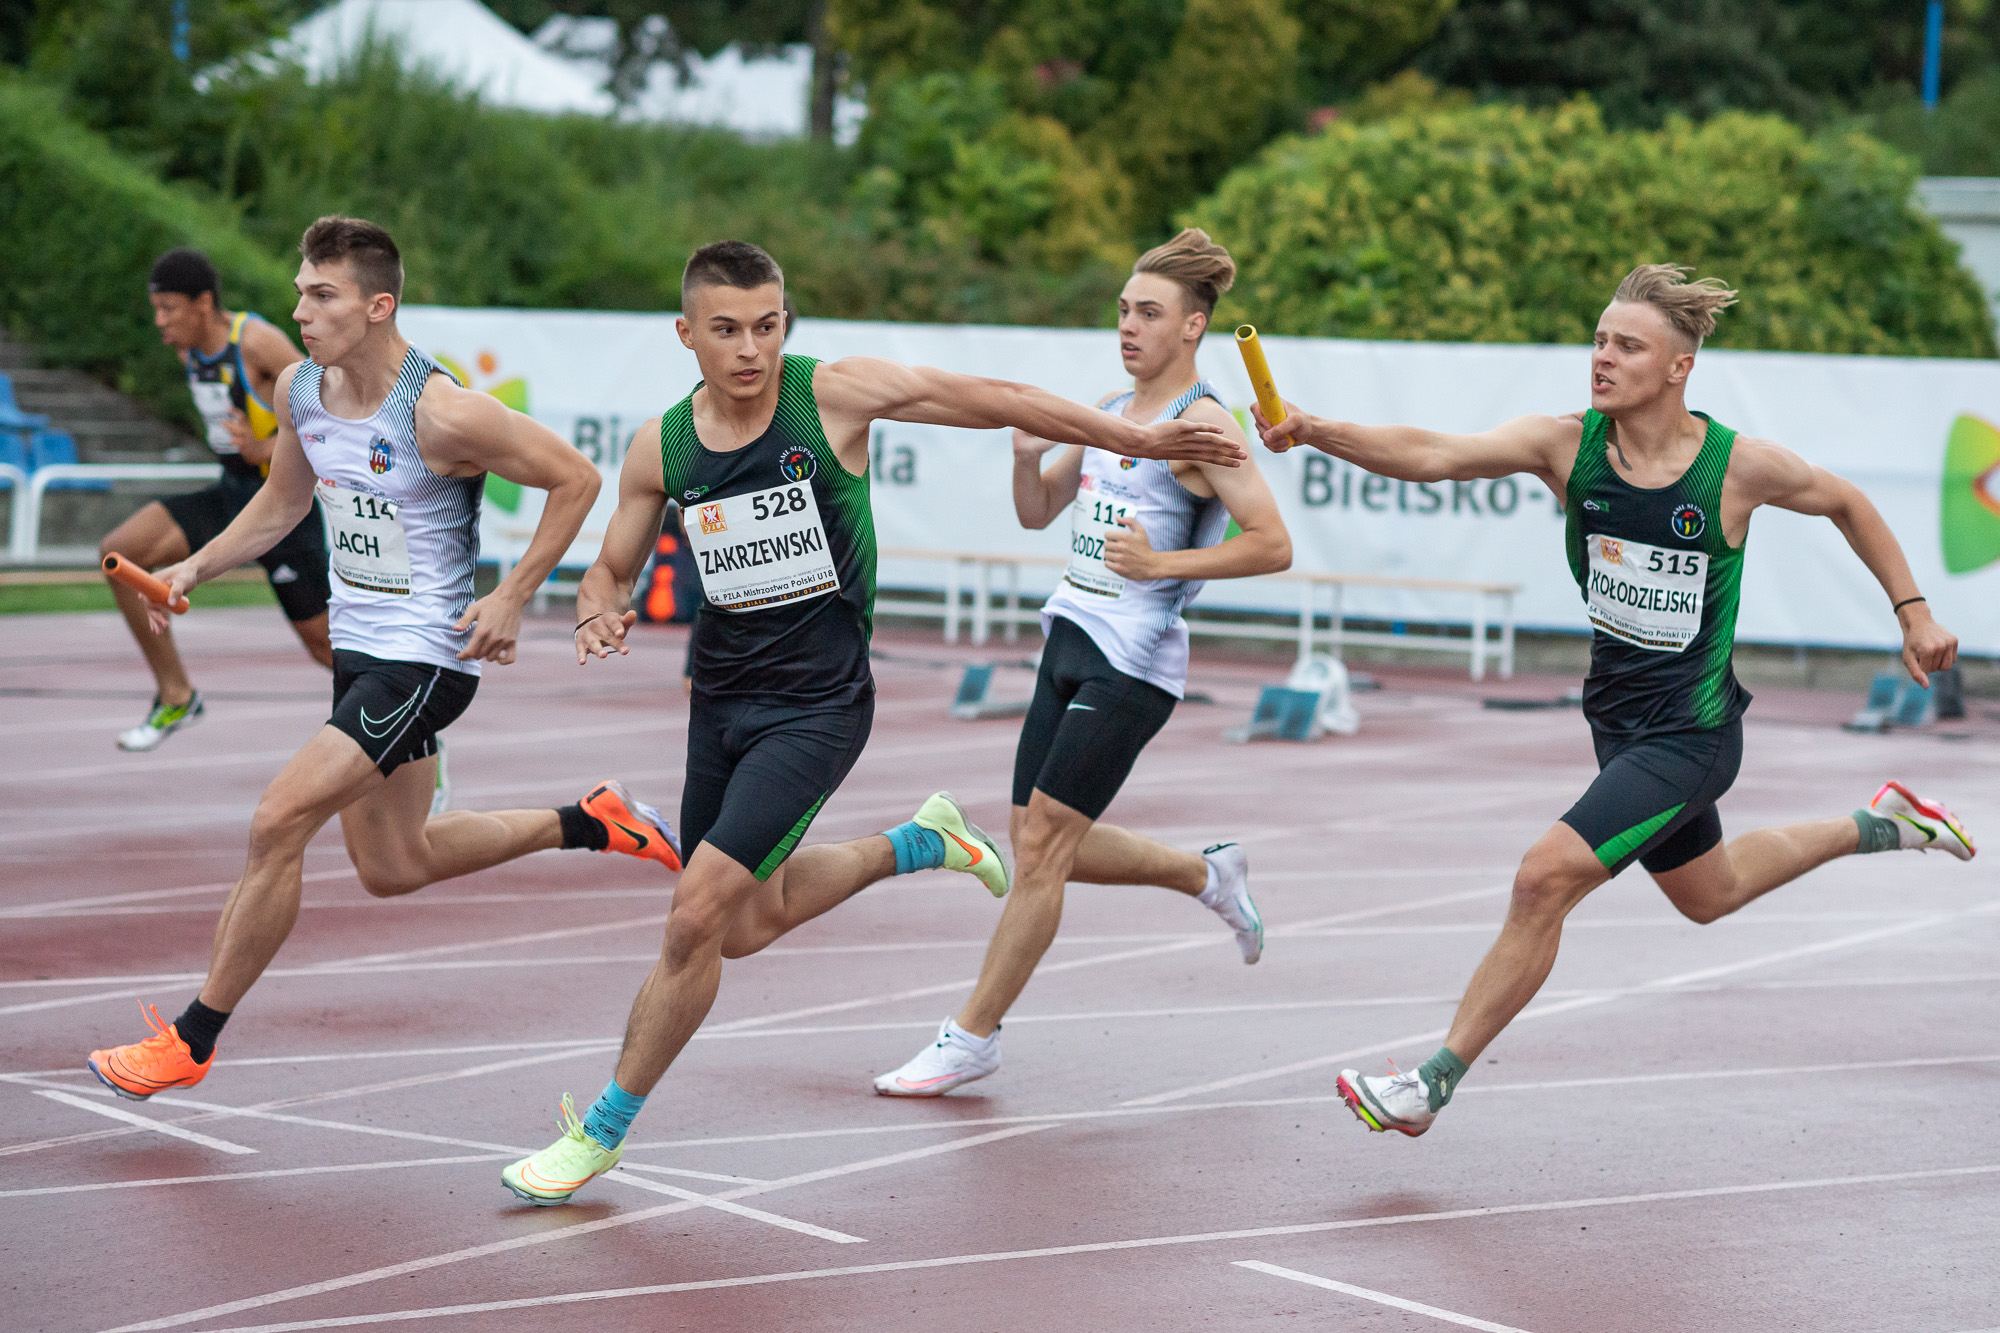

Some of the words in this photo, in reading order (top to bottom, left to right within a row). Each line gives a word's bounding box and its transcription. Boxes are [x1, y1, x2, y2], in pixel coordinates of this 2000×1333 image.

[574, 415, 627, 466] Bi
[1304, 454, 1568, 517] Bielsko-
[353, 495, 394, 520] 114
[752, 487, 807, 521] 528
[1093, 501, 1126, 528] 111
[332, 526, 380, 558] LACH
[702, 522, 727, 533] PZLA
[700, 527, 823, 575] ZAKRZEWSKI
[1647, 550, 1700, 576] 515
[374, 575, 393, 584] Polski
[710, 595, 723, 603] 54.
[723, 591, 743, 601] PZLA
[743, 583, 789, 598] Mistrzostwa
[790, 575, 816, 588] Polski
[817, 569, 834, 580] U18
[1591, 569, 1697, 614] KOŁODZIEJSKI
[1614, 619, 1654, 636] Mistrzostwa
[1655, 630, 1680, 639] Polski
